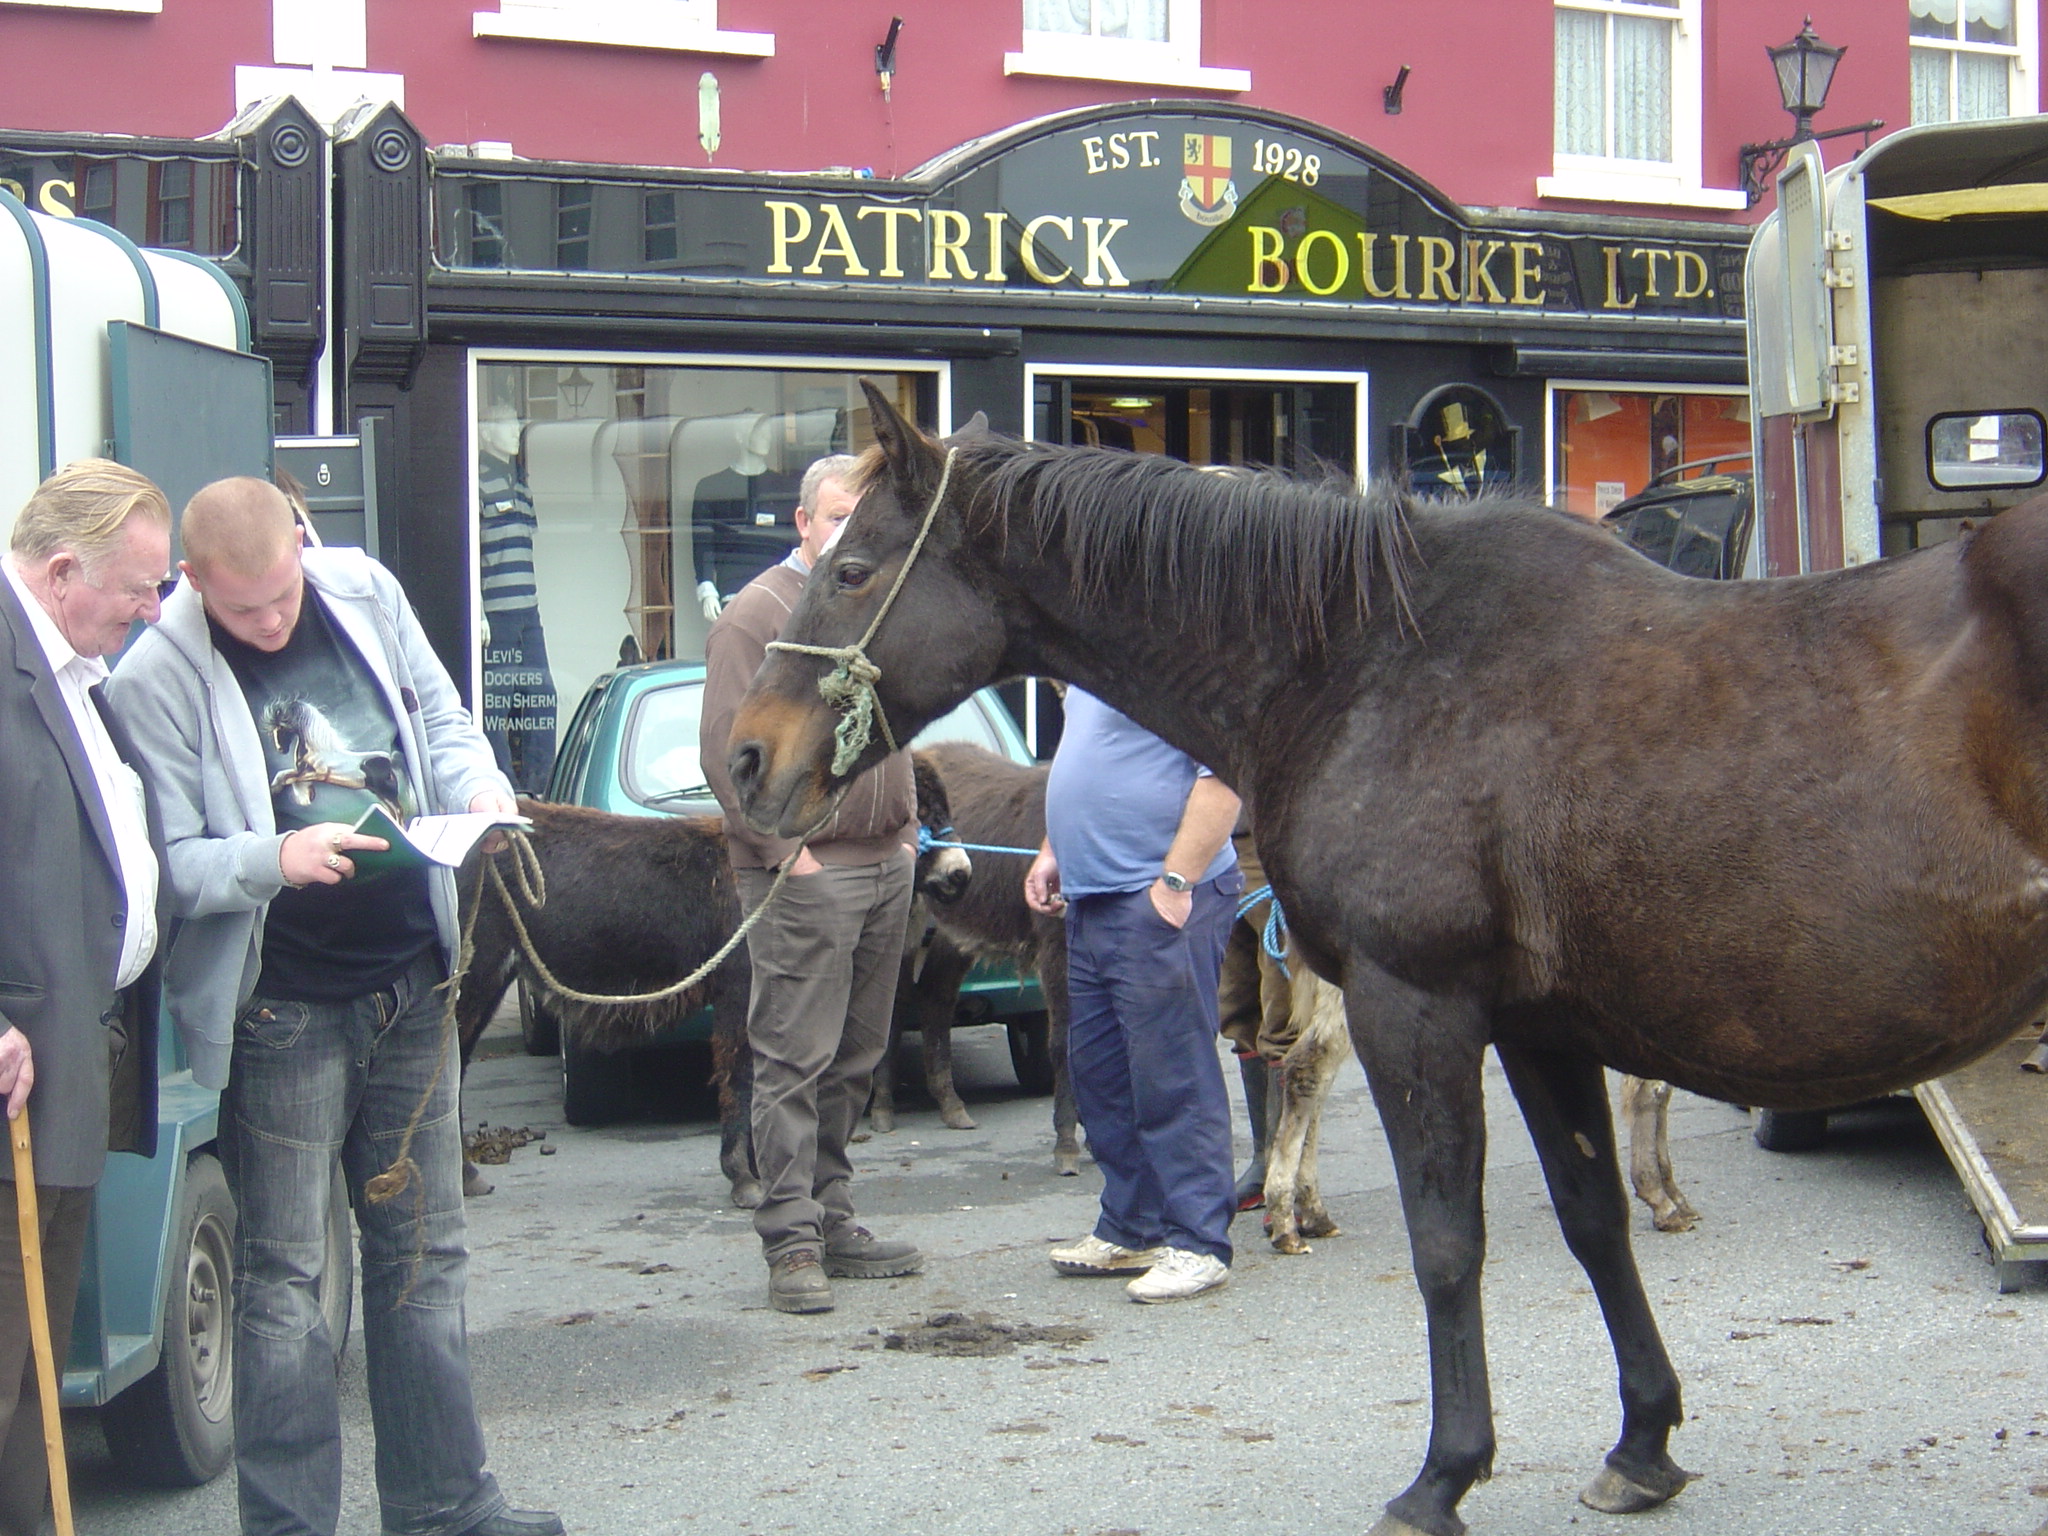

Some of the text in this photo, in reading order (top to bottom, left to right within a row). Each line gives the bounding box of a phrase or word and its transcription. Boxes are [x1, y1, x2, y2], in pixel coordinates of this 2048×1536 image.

[1082, 131, 1322, 187] EST. 1928
[764, 200, 1715, 309] PATRICK BOURKE LTD.
[484, 648, 522, 664] LEVI'S
[484, 671, 543, 686] DOCKERS
[484, 692, 572, 709] BEN SHERM
[484, 715, 555, 731] WRANGLER
